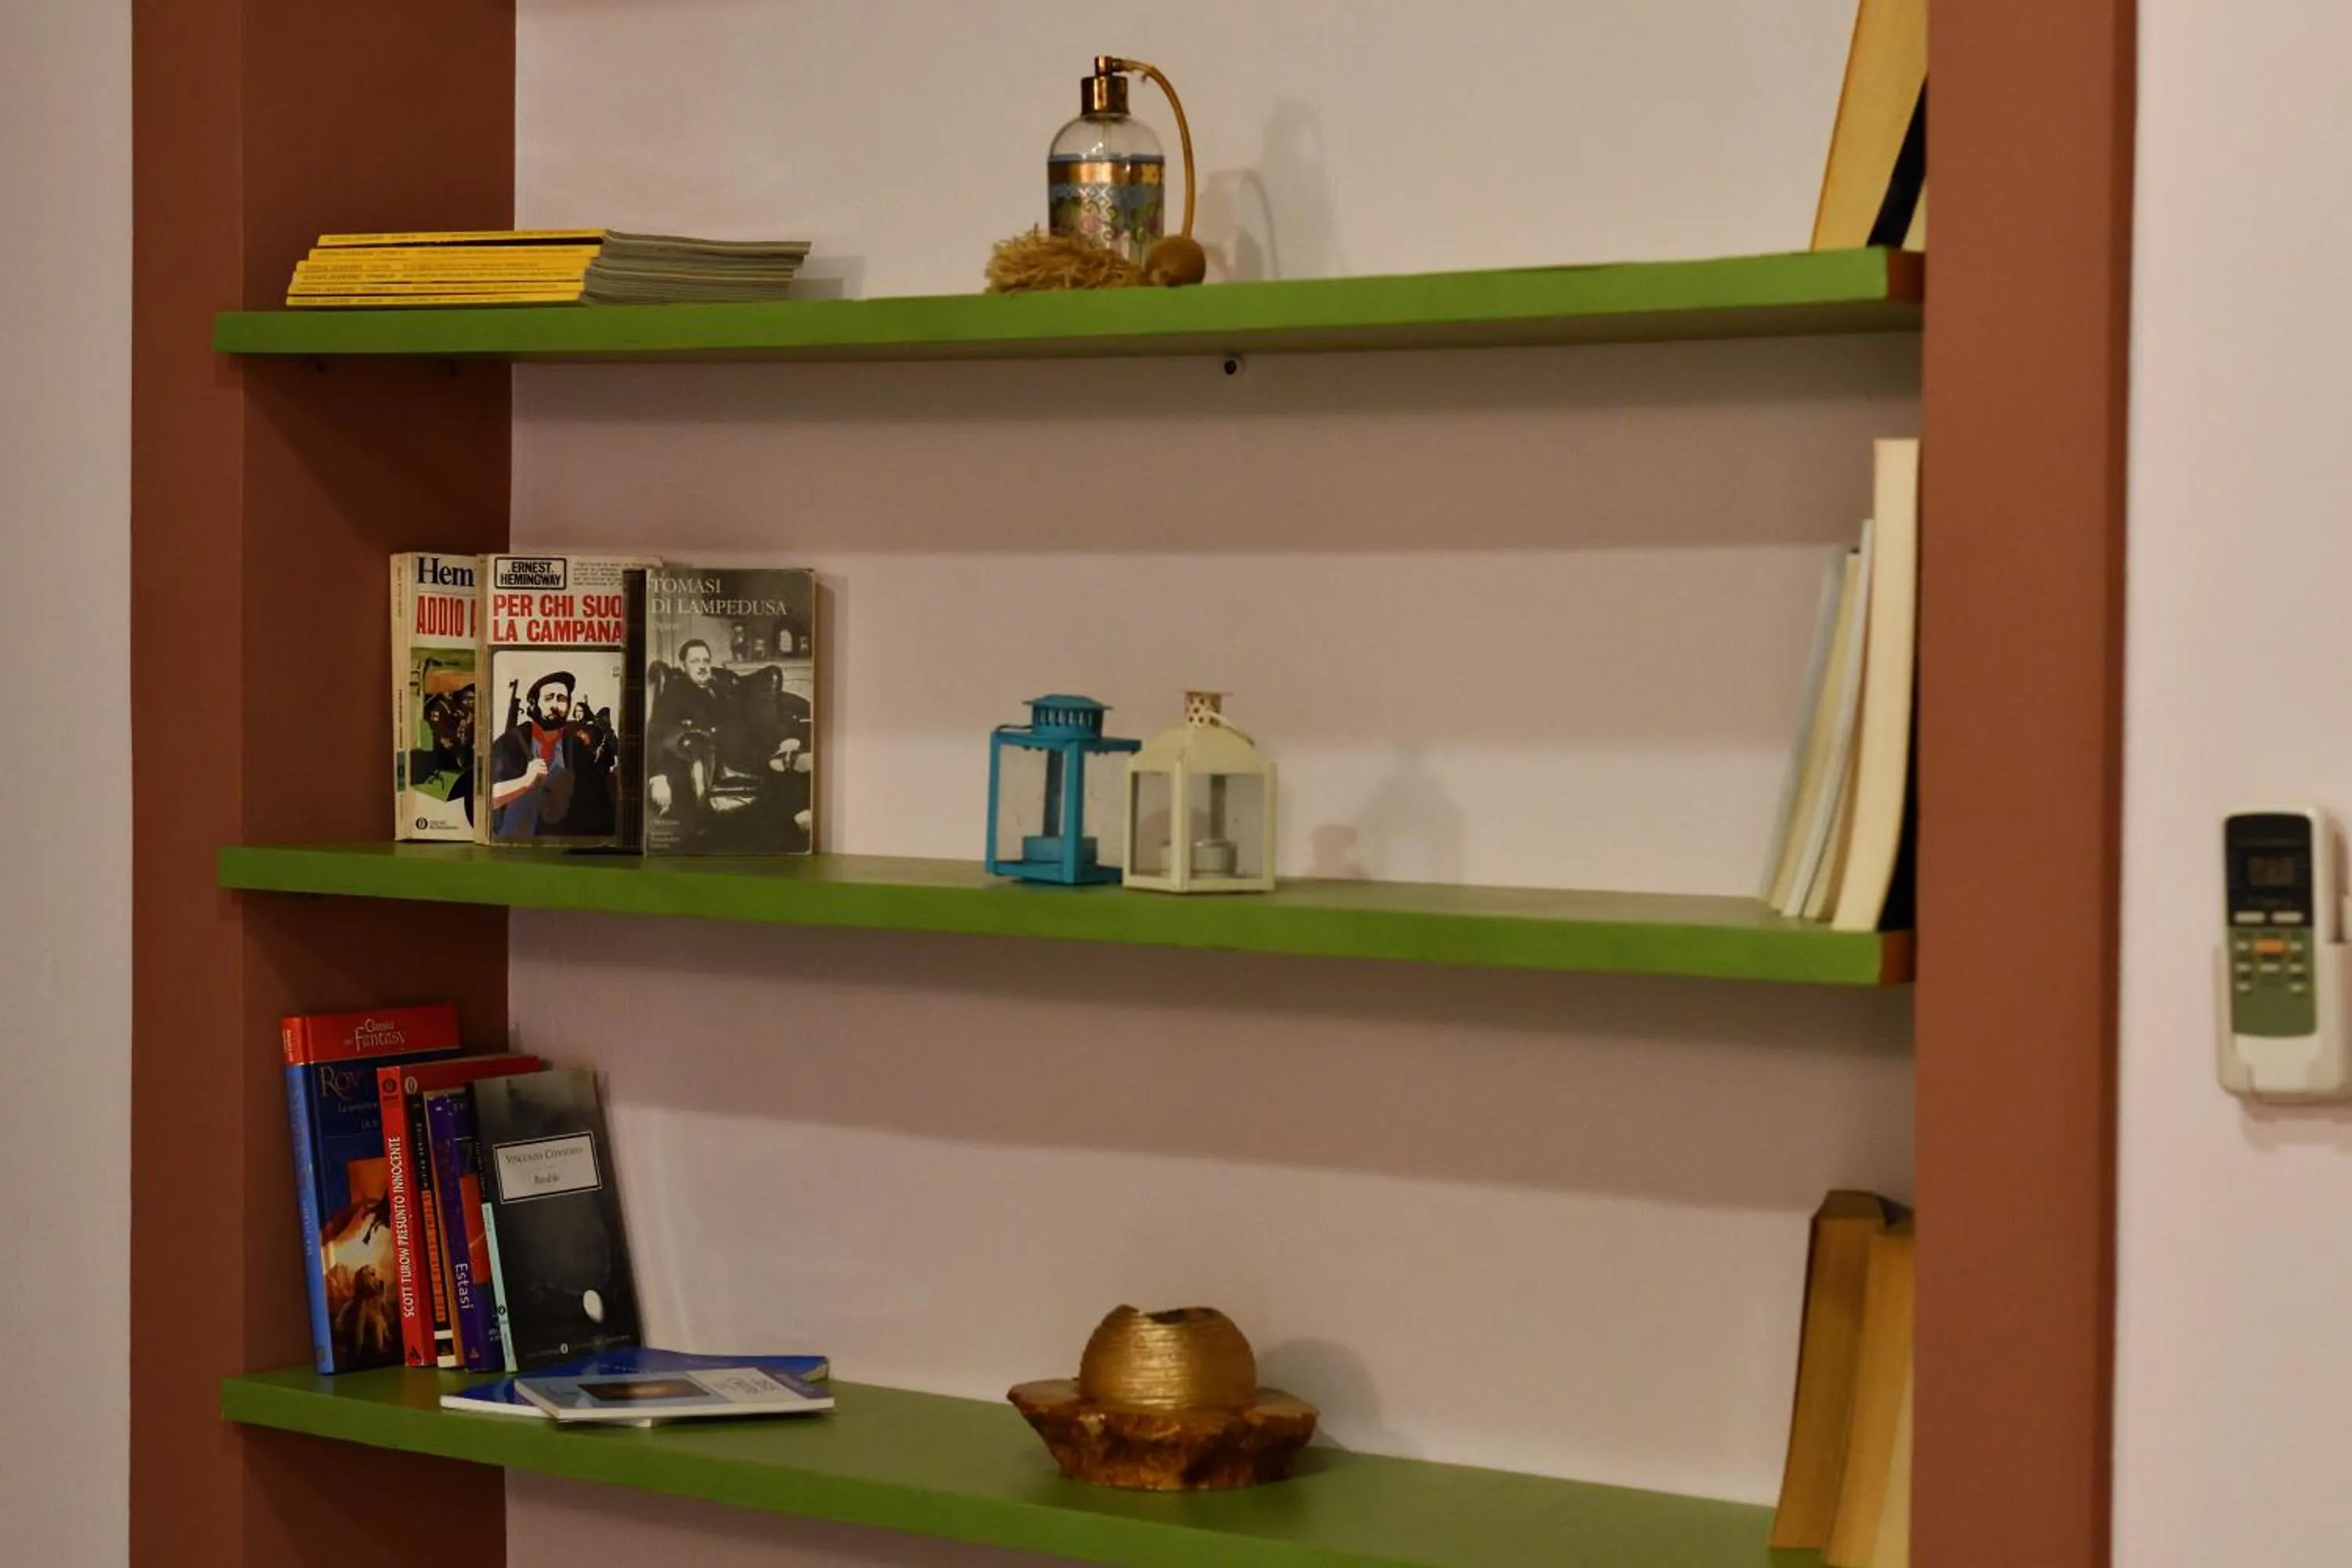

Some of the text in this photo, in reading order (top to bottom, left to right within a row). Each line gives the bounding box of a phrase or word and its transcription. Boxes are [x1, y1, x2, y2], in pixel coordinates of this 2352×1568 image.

[511, 561, 553, 573] ERNEST
[500, 574, 561, 586] HEMINGWAY
[650, 578, 720, 593] TOMASI
[416, 595, 465, 637] ADDIO
[493, 594, 533, 617] PER
[539, 595, 574, 617] CHI
[651, 598, 788, 615] DI LAMPEDUSA
[493, 619, 518, 641] LA
[526, 619, 623, 643] CAMPANA
[354, 1025, 405, 1051] Fantasy
[388, 1136, 415, 1318] SCOTT TUROW PRESUNTO INNOCENTE
[454, 1262, 474, 1309] Estasi
